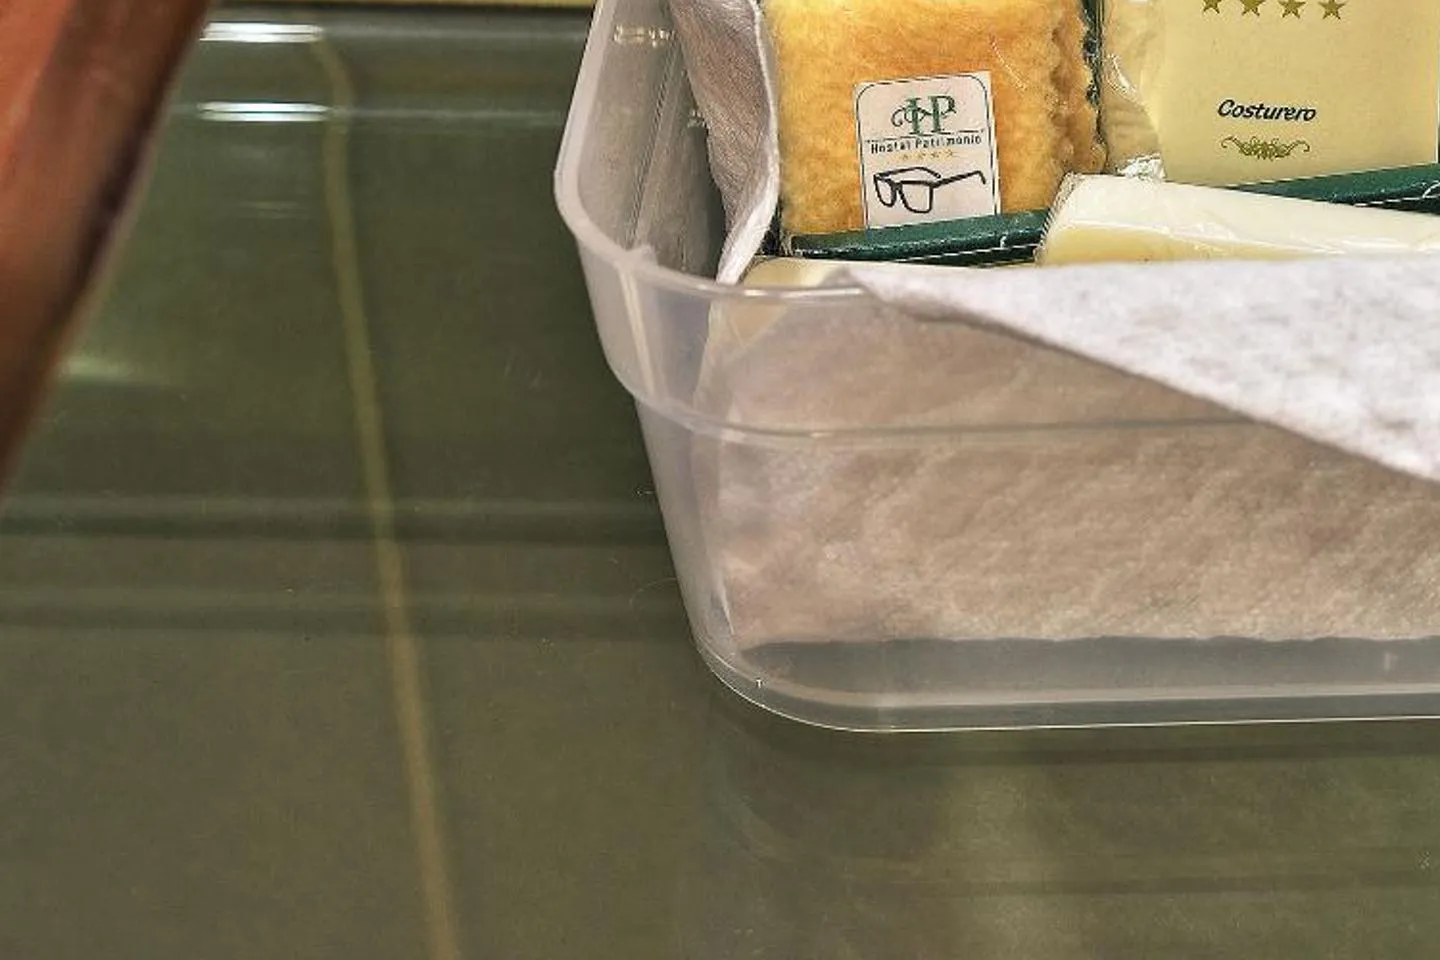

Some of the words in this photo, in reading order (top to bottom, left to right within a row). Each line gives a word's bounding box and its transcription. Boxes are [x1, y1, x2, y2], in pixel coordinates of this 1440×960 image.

[890, 95, 957, 135] HP
[1216, 97, 1317, 123] Costurero
[870, 140, 911, 155] Hostal
[914, 134, 983, 150] Patrimonio
